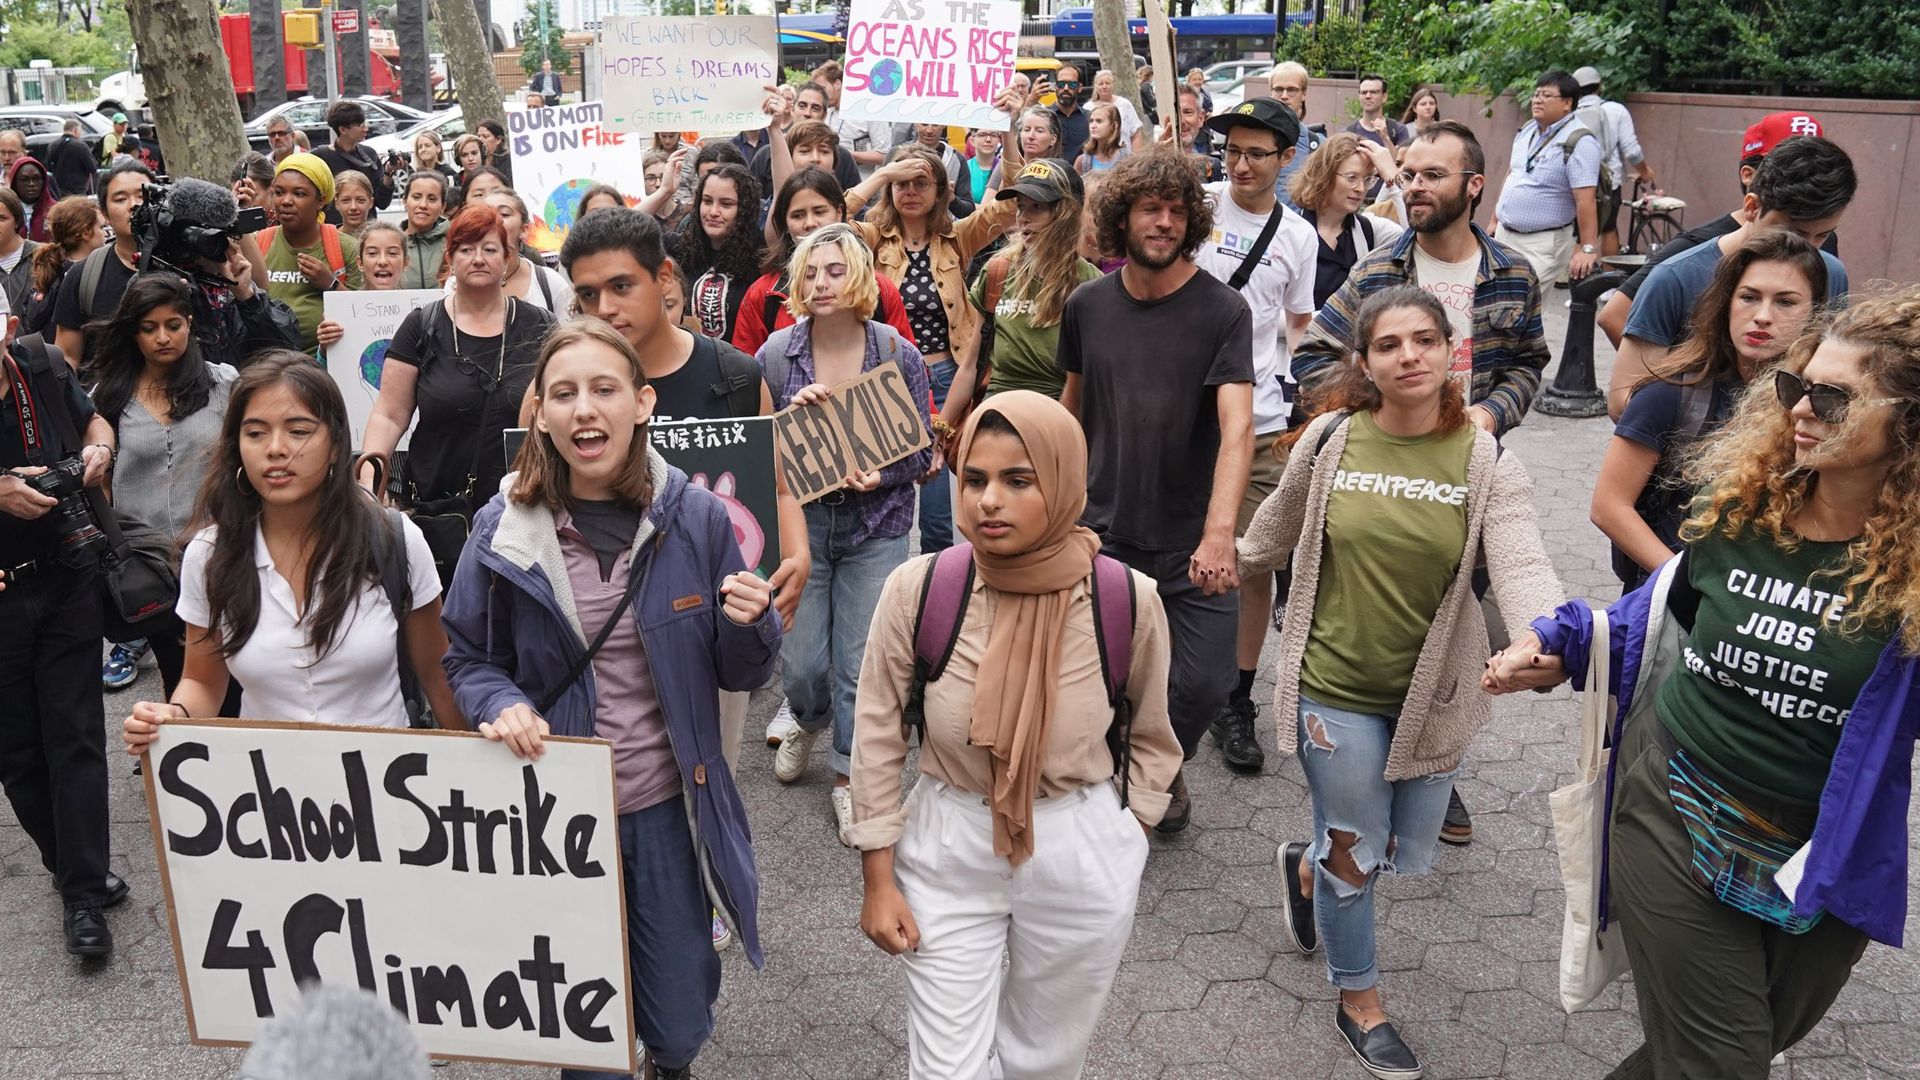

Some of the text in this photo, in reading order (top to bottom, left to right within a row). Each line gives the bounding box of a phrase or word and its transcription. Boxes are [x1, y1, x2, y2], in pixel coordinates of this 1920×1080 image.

[880, 0, 991, 26] AS THE
[649, 22, 706, 45] WANT
[708, 24, 759, 47] OUR
[848, 21, 957, 60] OCEANS
[604, 56, 667, 77] HOPES
[691, 59, 772, 79] DREAMS
[905, 60, 959, 98] WILL
[509, 108, 556, 134] OUR
[631, 108, 682, 127] GRETA
[514, 134, 533, 157] IS
[542, 130, 579, 153] ON
[365, 302, 401, 318] STAND
[371, 324, 395, 337] WHAT
[22, 406, 31, 419] 5D
[828, 370, 921, 474] KILLS
[24, 420, 36, 445] EOS
[1726, 568, 1847, 622] CLIMATE
[1735, 611, 1817, 652] JOBS
[1709, 640, 1829, 693] JUSTICE
[158, 741, 606, 879] School Strike
[201, 898, 276, 1018] 4
